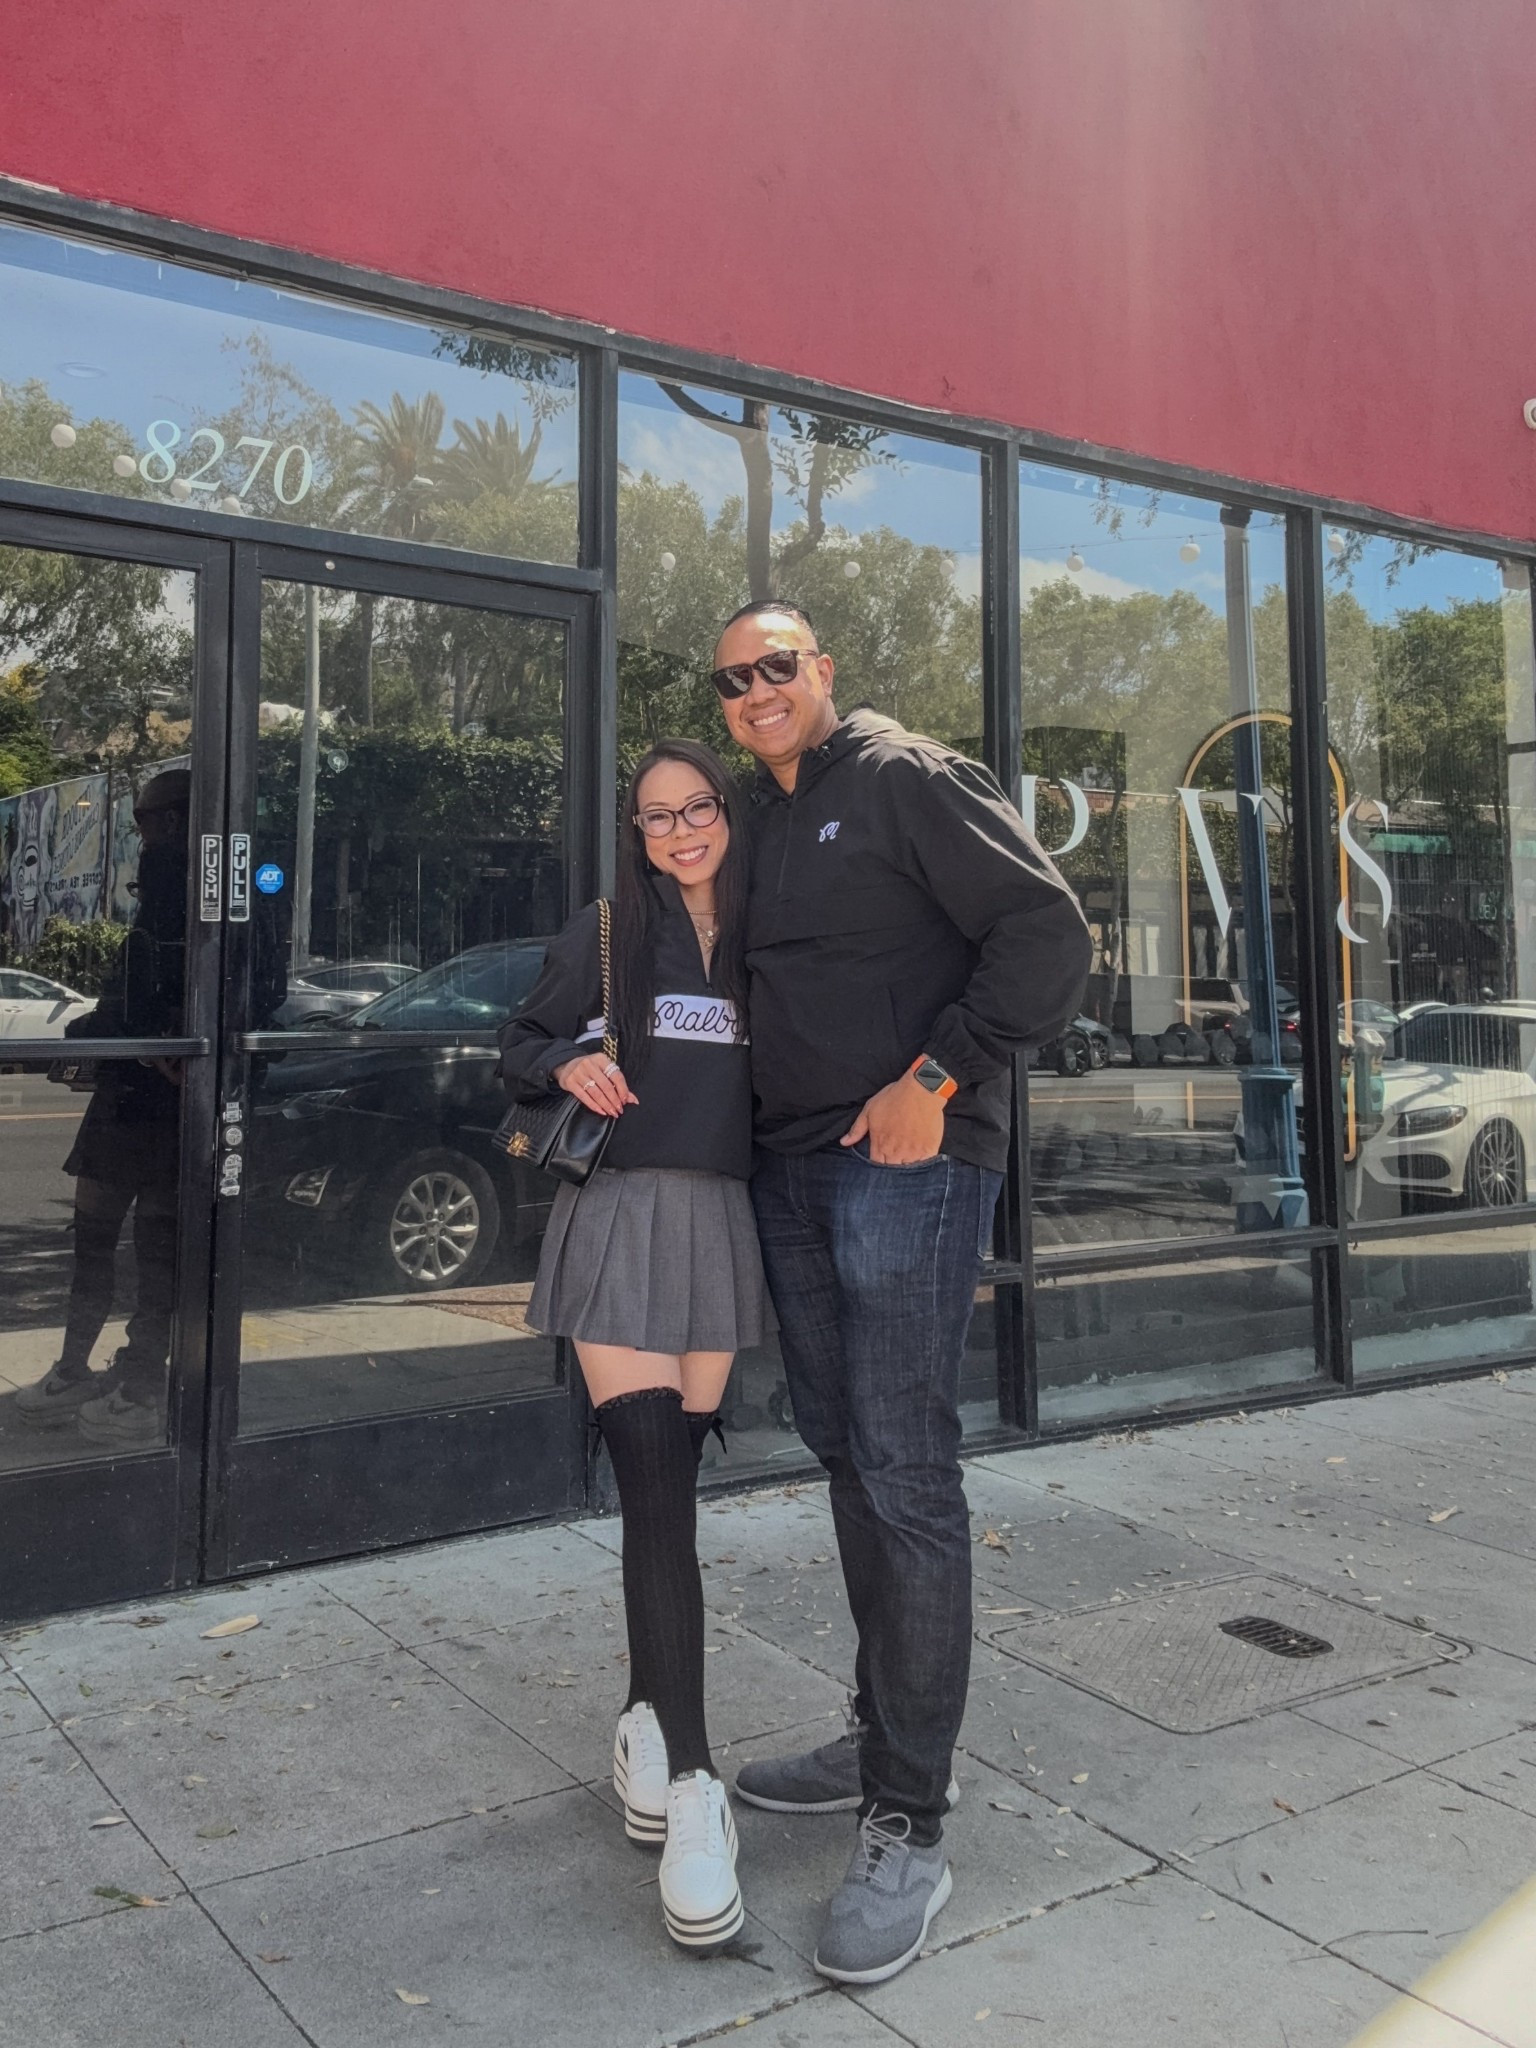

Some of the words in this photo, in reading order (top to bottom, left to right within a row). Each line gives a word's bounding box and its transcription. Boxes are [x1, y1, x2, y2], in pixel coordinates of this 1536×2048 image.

[139, 419, 313, 505] 8270
[205, 838, 218, 899] PUSH
[233, 841, 247, 899] PULL
[260, 871, 281, 881] ADT
